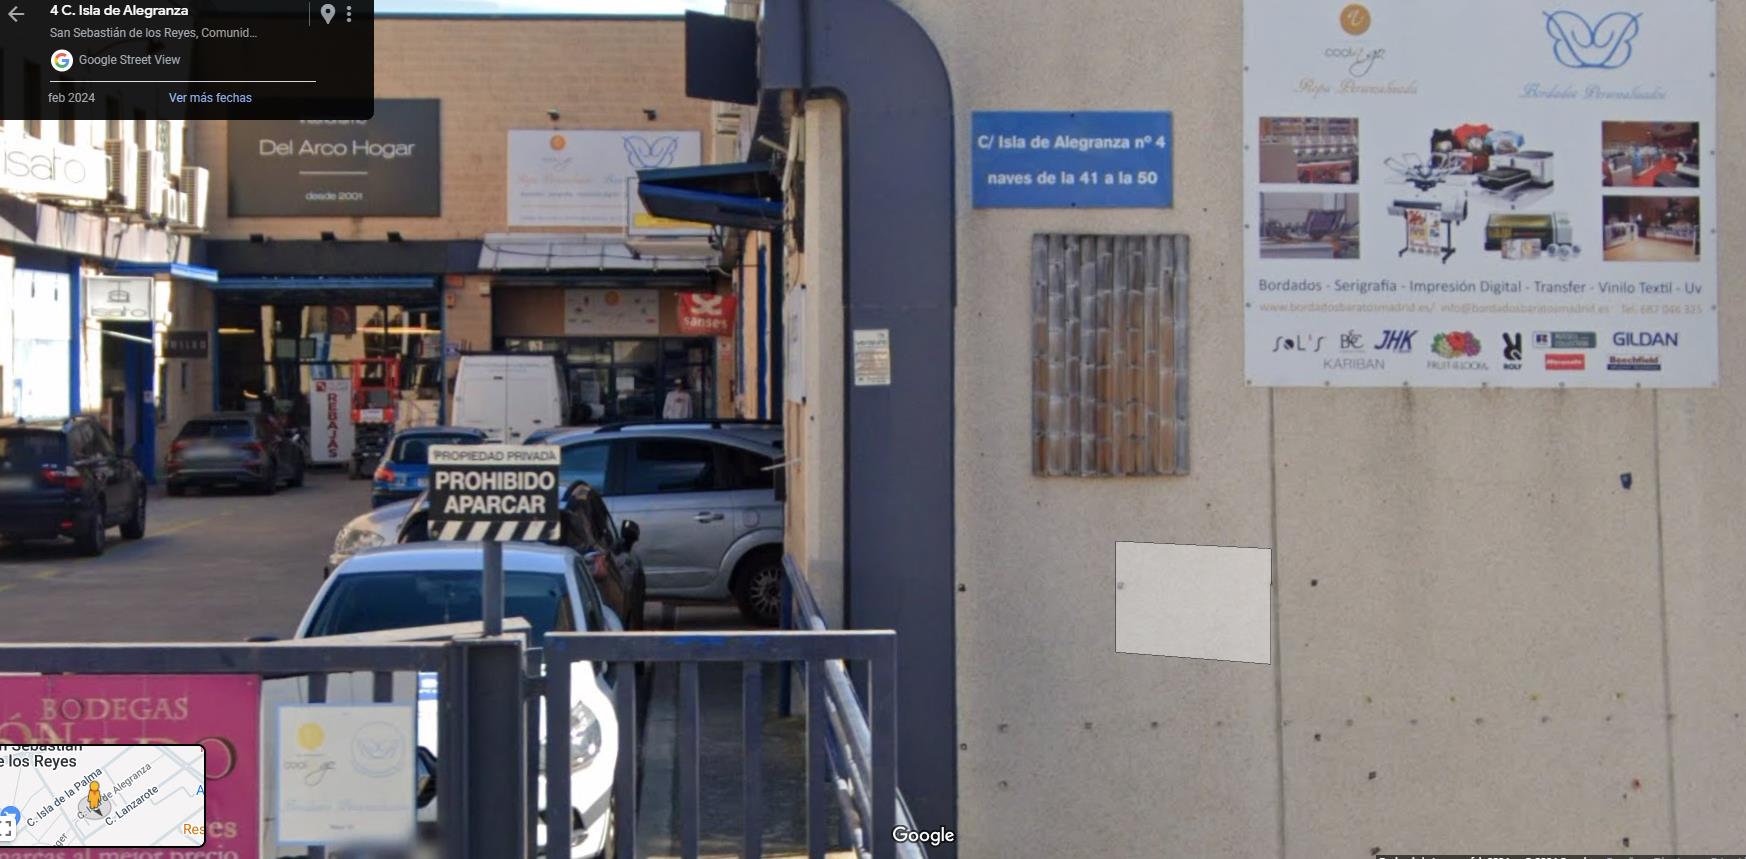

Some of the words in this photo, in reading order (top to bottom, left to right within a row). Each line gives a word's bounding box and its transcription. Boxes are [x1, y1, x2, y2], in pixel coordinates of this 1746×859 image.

[259, 139, 293, 156] Del
[299, 139, 348, 156] Arco
[352, 139, 415, 159] Hogar
[977, 136, 993, 149] C/
[999, 136, 1026, 149] Isla
[1030, 136, 1050, 149] de
[1054, 136, 1130, 152] Alegranza
[1155, 137, 1166, 149] 4
[987, 172, 1032, 185] naves
[1036, 171, 1056, 185] de
[1061, 171, 1075, 185] la
[1079, 172, 1098, 185] 41
[1104, 174, 1114, 185] a
[1118, 171, 1132, 185] la
[1137, 172, 1158, 185] 50
[305, 192, 336, 201] desde
[338, 192, 363, 201] 2001
[1259, 279, 1322, 292] Bordados
[1334, 279, 1397, 295] Serigrafía
[1409, 279, 1476, 294] Impresión
[1480, 280, 1521, 296] Digital
[1534, 281, 1586, 294] Transfer
[1599, 281, 1635, 295] Vinilo
[1639, 281, 1672, 295] Textil
[1685, 282, 1702, 295] Uv
[684, 317, 728, 328] sanses
[1374, 330, 1418, 350] JHK
[1613, 332, 1678, 346] GILDAN
[1323, 358, 1385, 369] KARIBAN
[327, 393, 338, 458] REBAJAS
[433, 450, 504, 461] PROPIEDAD
[507, 450, 557, 461] PRIVADA
[435, 470, 556, 490] PROHIBIDO
[443, 493, 546, 514] APARCAR
[41, 697, 189, 721] BODEGAS
